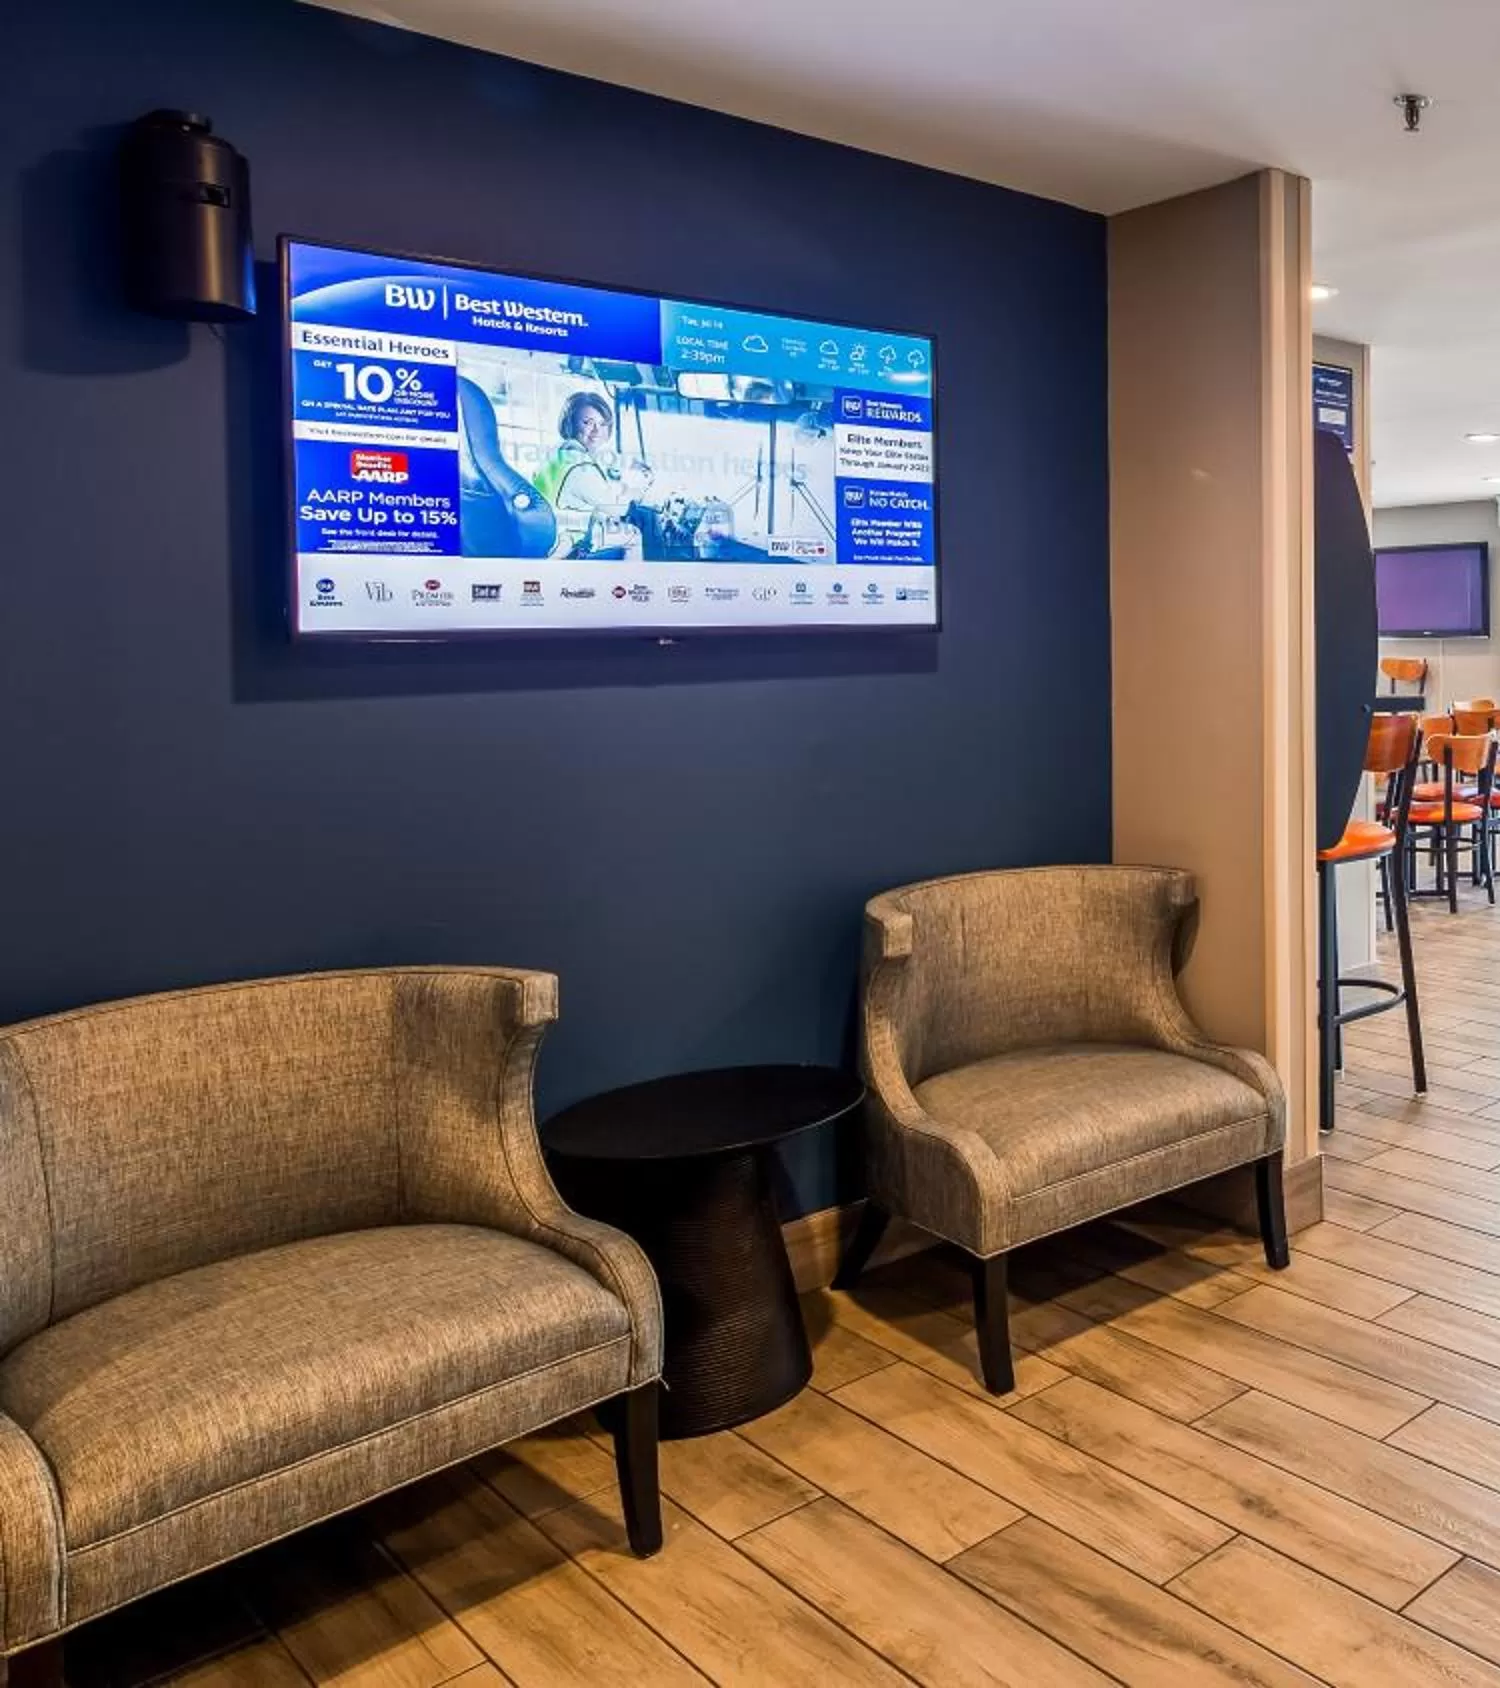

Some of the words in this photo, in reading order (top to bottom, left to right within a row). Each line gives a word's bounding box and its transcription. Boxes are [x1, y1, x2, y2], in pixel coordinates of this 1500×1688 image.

[385, 283, 435, 311] BW
[455, 293, 500, 316] Best
[472, 316, 511, 331] Hotels
[513, 321, 523, 331] &
[525, 323, 569, 337] Resorts
[303, 330, 383, 352] Essential
[389, 341, 450, 359] Heroes
[676, 336, 705, 347] LOCAL
[313, 359, 332, 369] GET
[352, 470, 409, 483] AARP
[307, 488, 364, 504] AARP
[369, 491, 451, 508] Members
[300, 505, 352, 522] Save
[357, 507, 387, 525] Up
[393, 509, 415, 524] to
[420, 510, 457, 526] 15%
